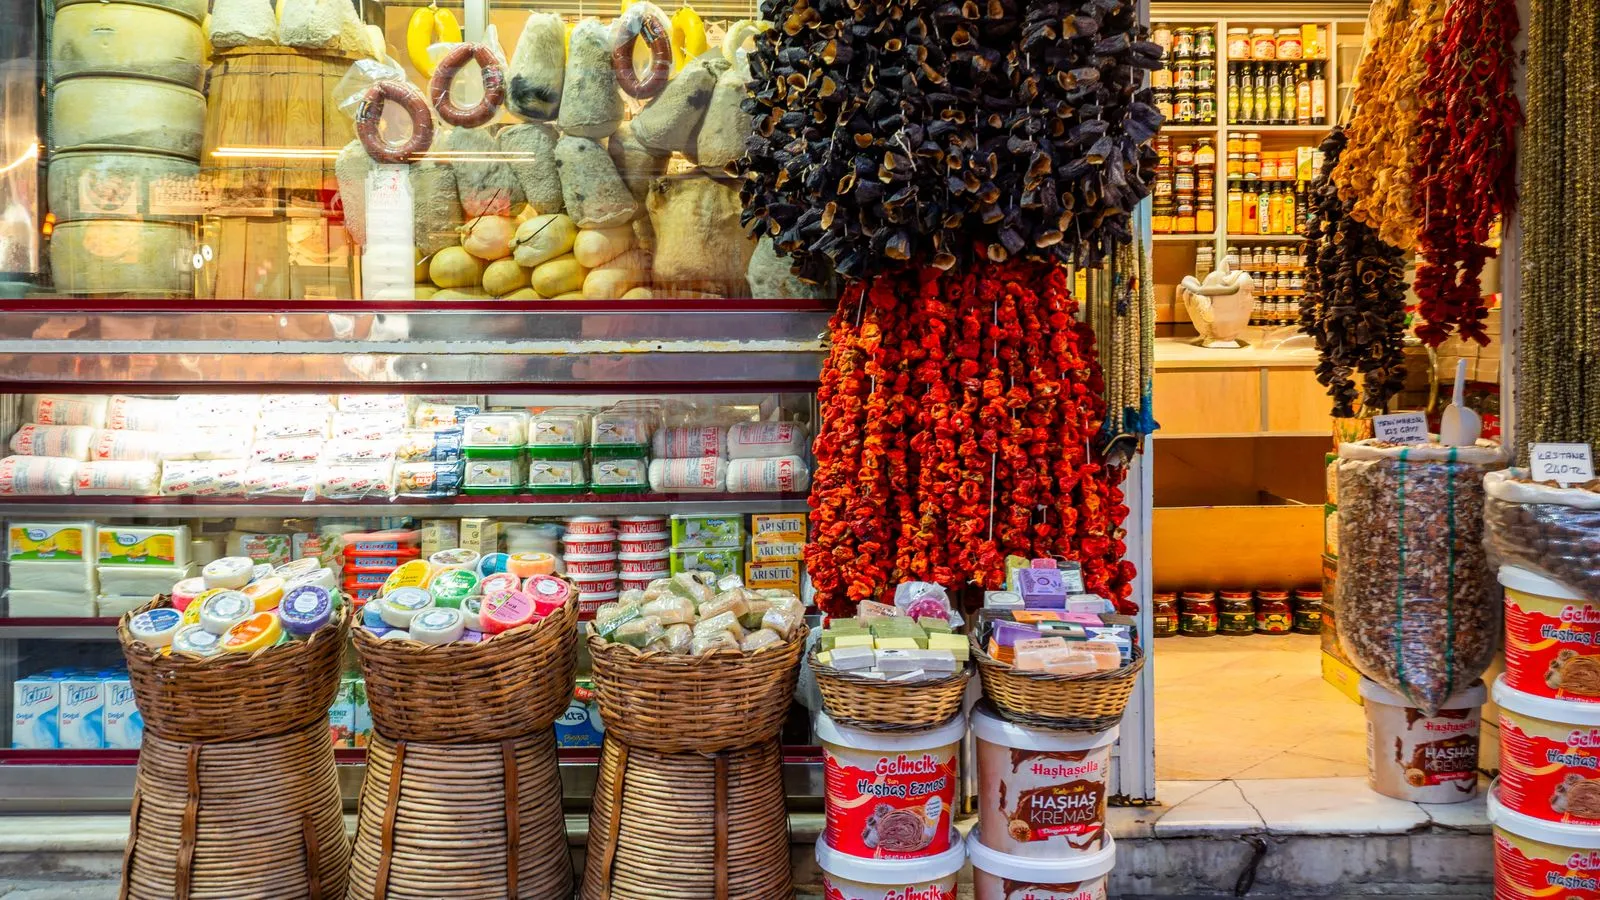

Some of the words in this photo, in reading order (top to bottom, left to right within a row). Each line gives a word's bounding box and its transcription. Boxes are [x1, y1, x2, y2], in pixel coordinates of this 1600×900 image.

[1537, 451, 1587, 460] KESTANE
[760, 521, 775, 531] ARI
[752, 570, 767, 580] ARI
[768, 568, 792, 579] SÜTÜ
[563, 711, 585, 721] kta
[875, 755, 936, 774] Gelincik
[1030, 761, 1098, 778] Haşhaşella
[858, 779, 906, 797] Haşhaş
[1032, 792, 1097, 812] HAŞHAŞ
[1031, 805, 1096, 825] KREMASI
